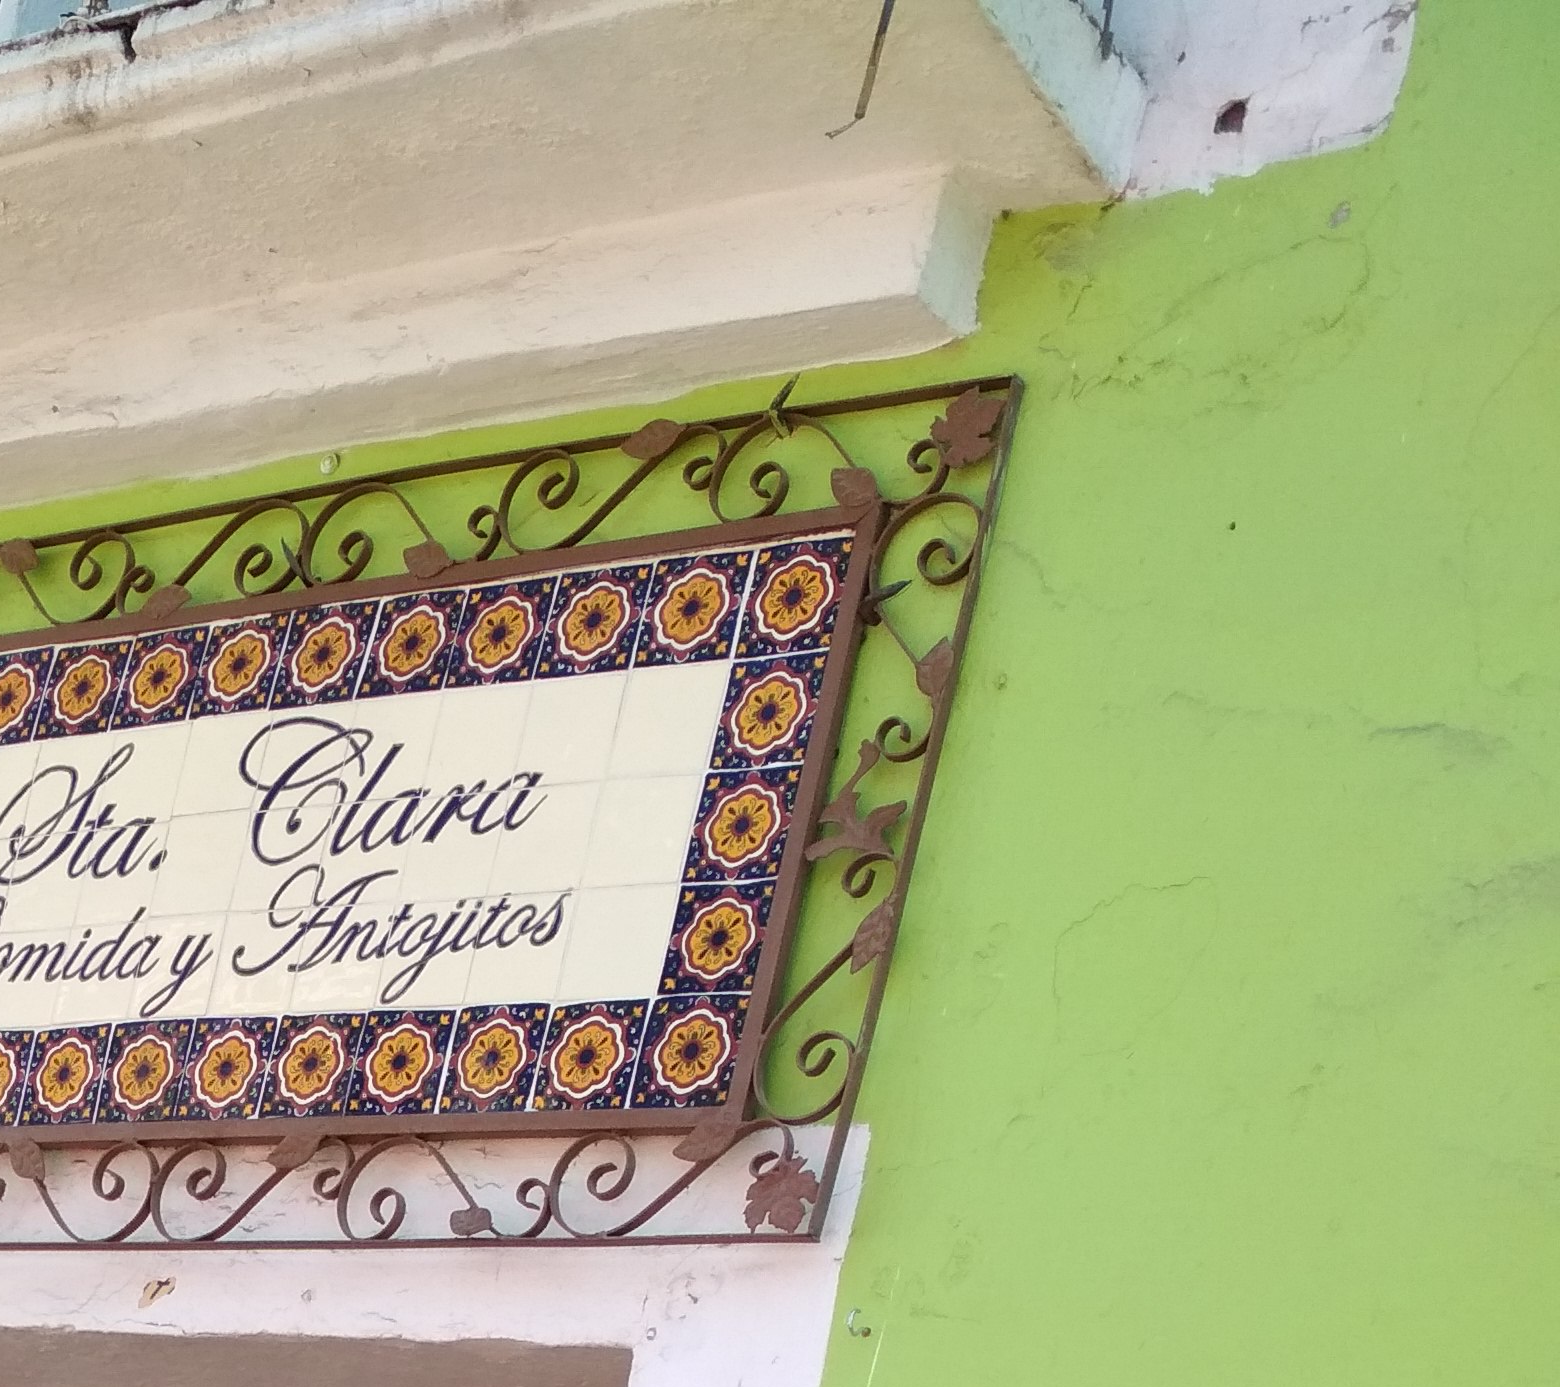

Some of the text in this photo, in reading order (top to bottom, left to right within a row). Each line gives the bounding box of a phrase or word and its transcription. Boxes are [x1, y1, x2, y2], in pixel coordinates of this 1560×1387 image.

[240, 716, 549, 866] Clara
[144, 943, 213, 1018] y
[232, 864, 574, 1005] Antojitos
